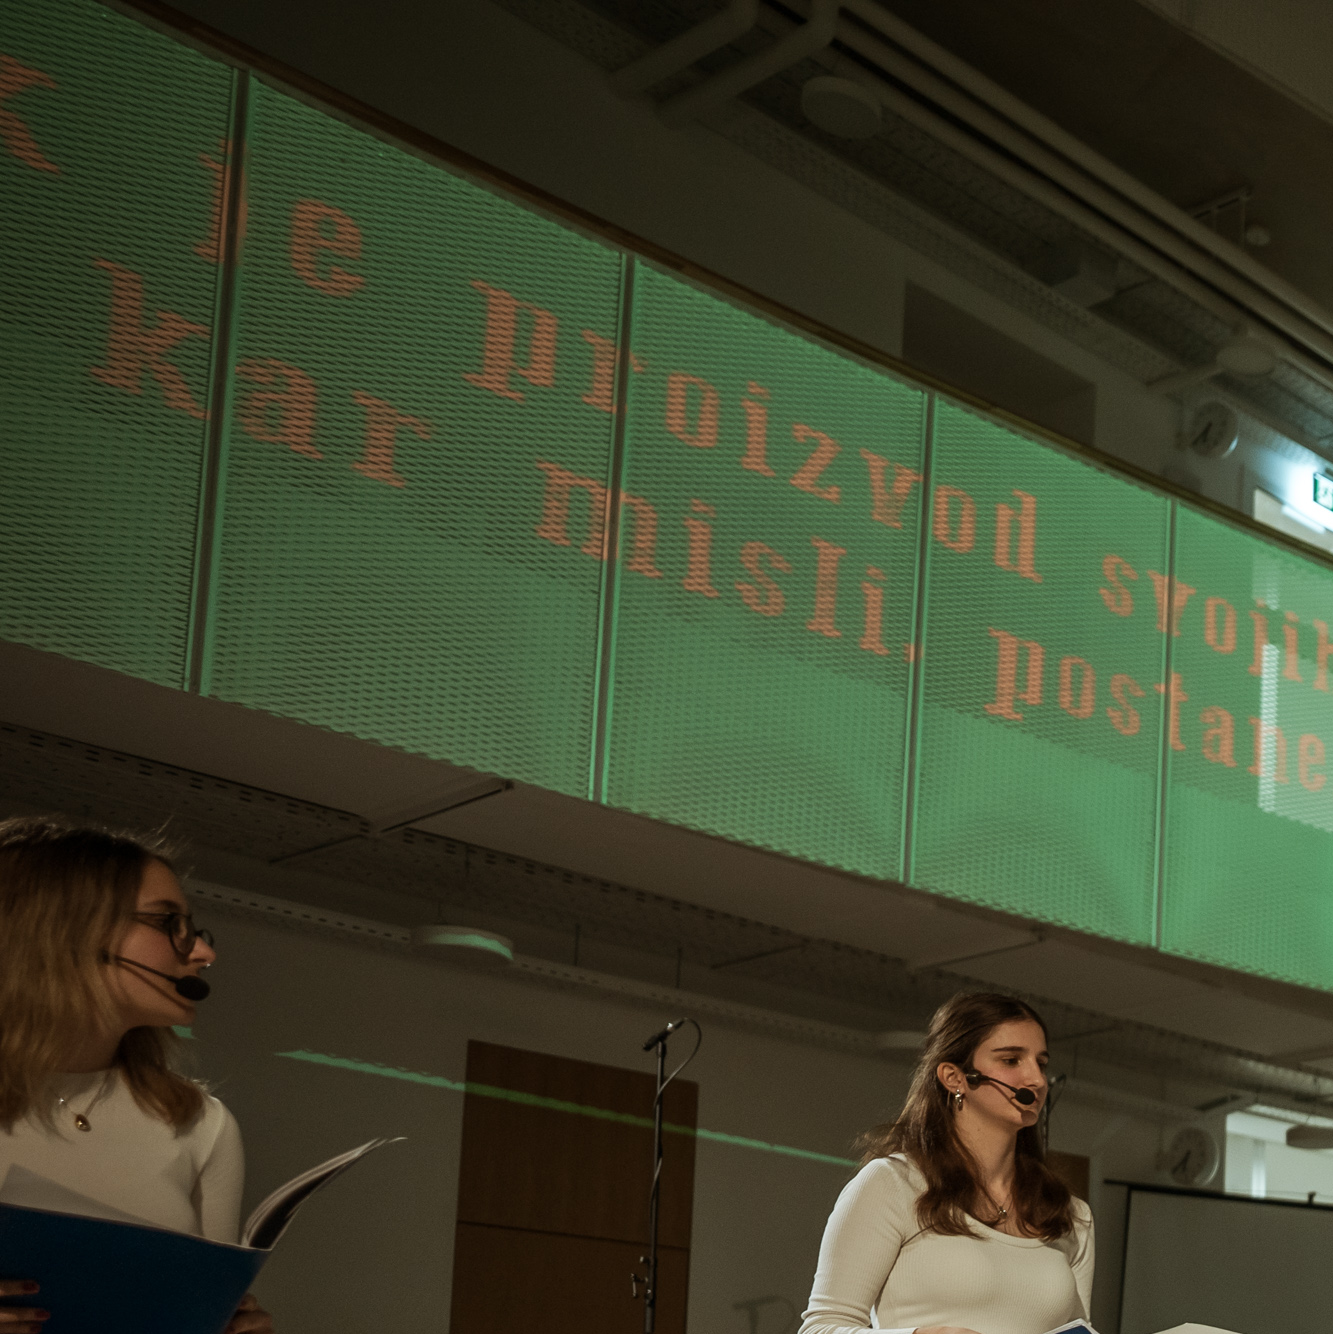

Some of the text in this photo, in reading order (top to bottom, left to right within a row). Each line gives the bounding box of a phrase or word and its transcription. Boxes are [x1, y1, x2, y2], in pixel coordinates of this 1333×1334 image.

[90, 257, 433, 488] kar
[194, 137, 365, 298] je
[461, 279, 1043, 583] proizvod
